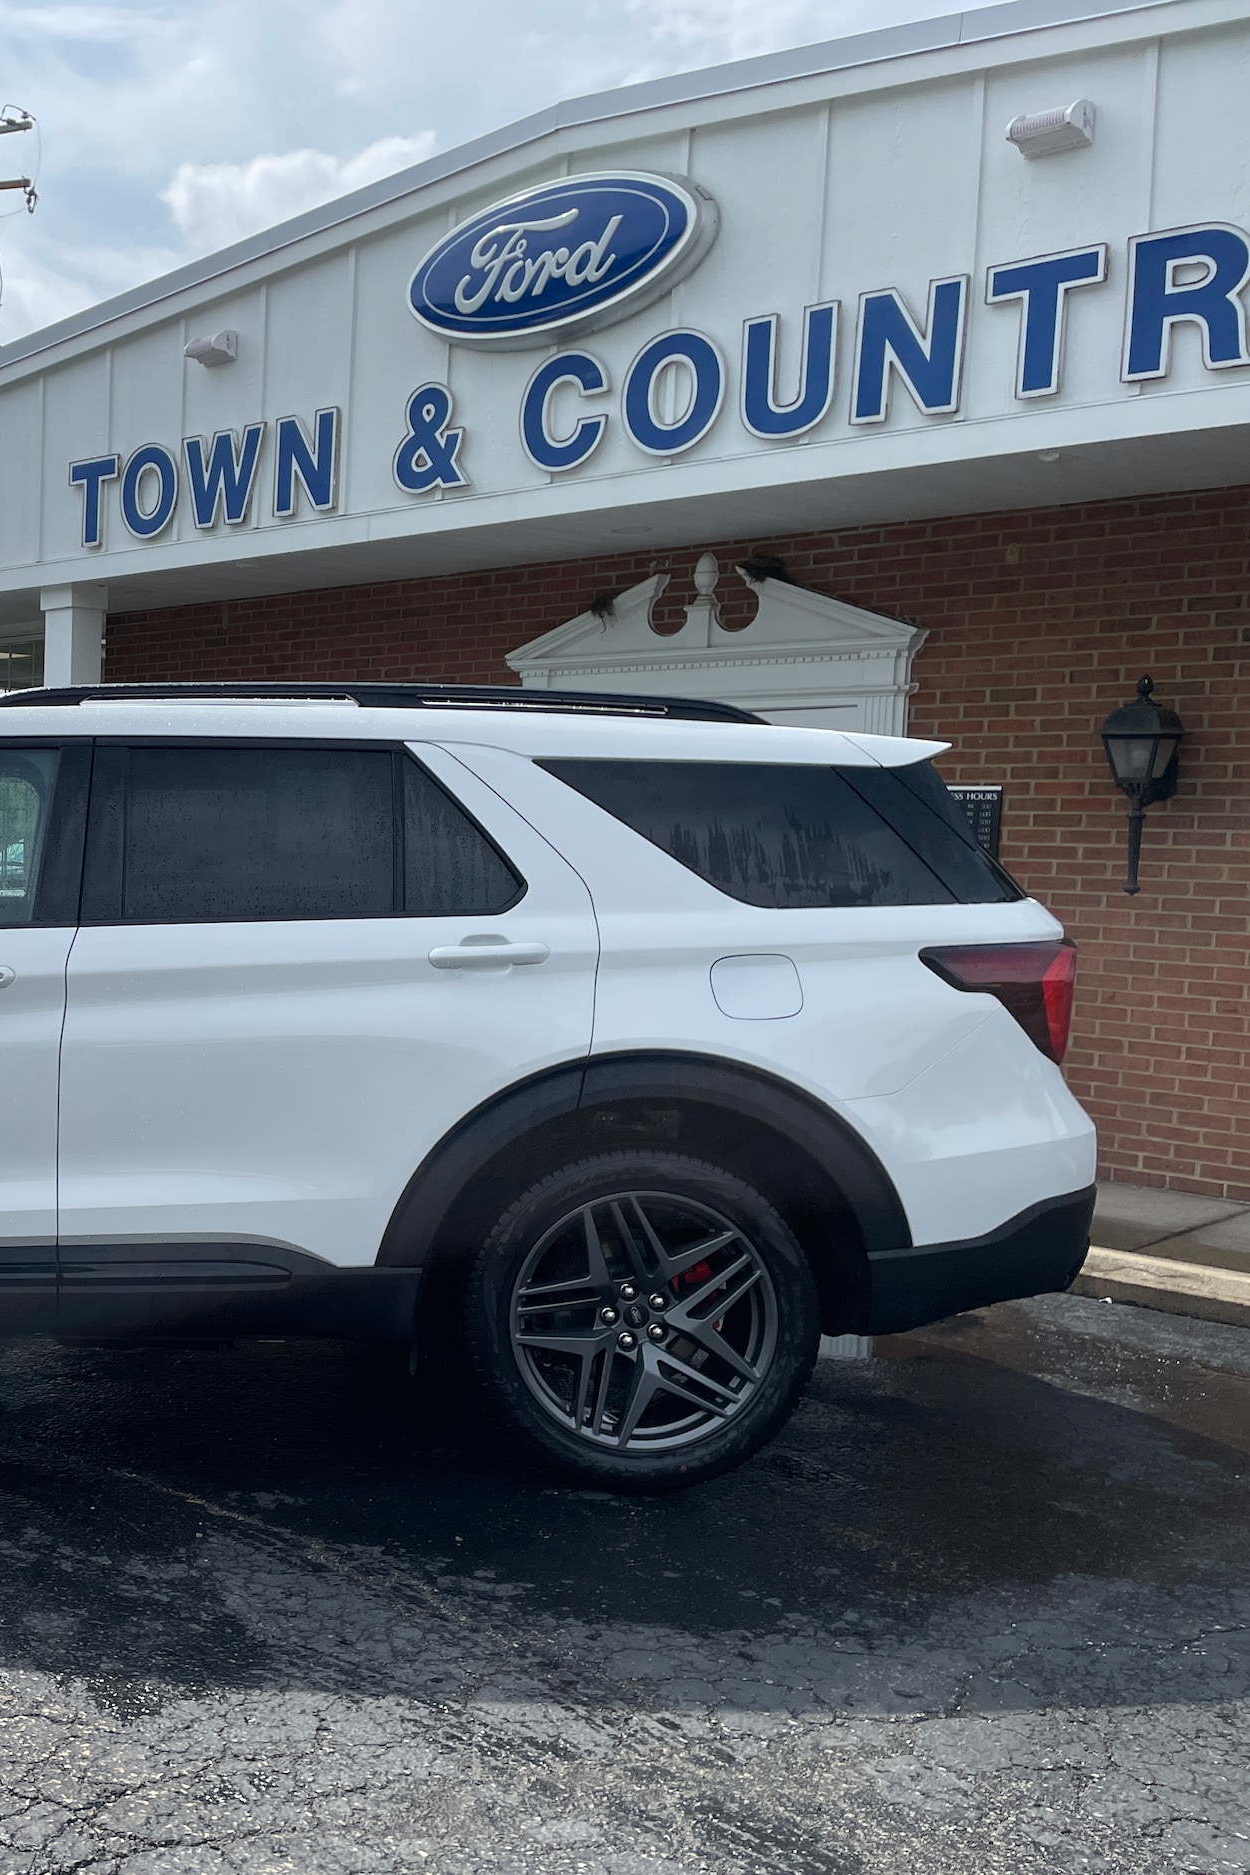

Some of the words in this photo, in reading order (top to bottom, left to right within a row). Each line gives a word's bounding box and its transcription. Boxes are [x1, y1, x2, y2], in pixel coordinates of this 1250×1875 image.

[454, 207, 624, 315] Ford
[69, 405, 340, 548] TOWN
[392, 382, 471, 494] &
[519, 221, 1250, 473] COUNTR
[966, 792, 998, 801] HOURS
